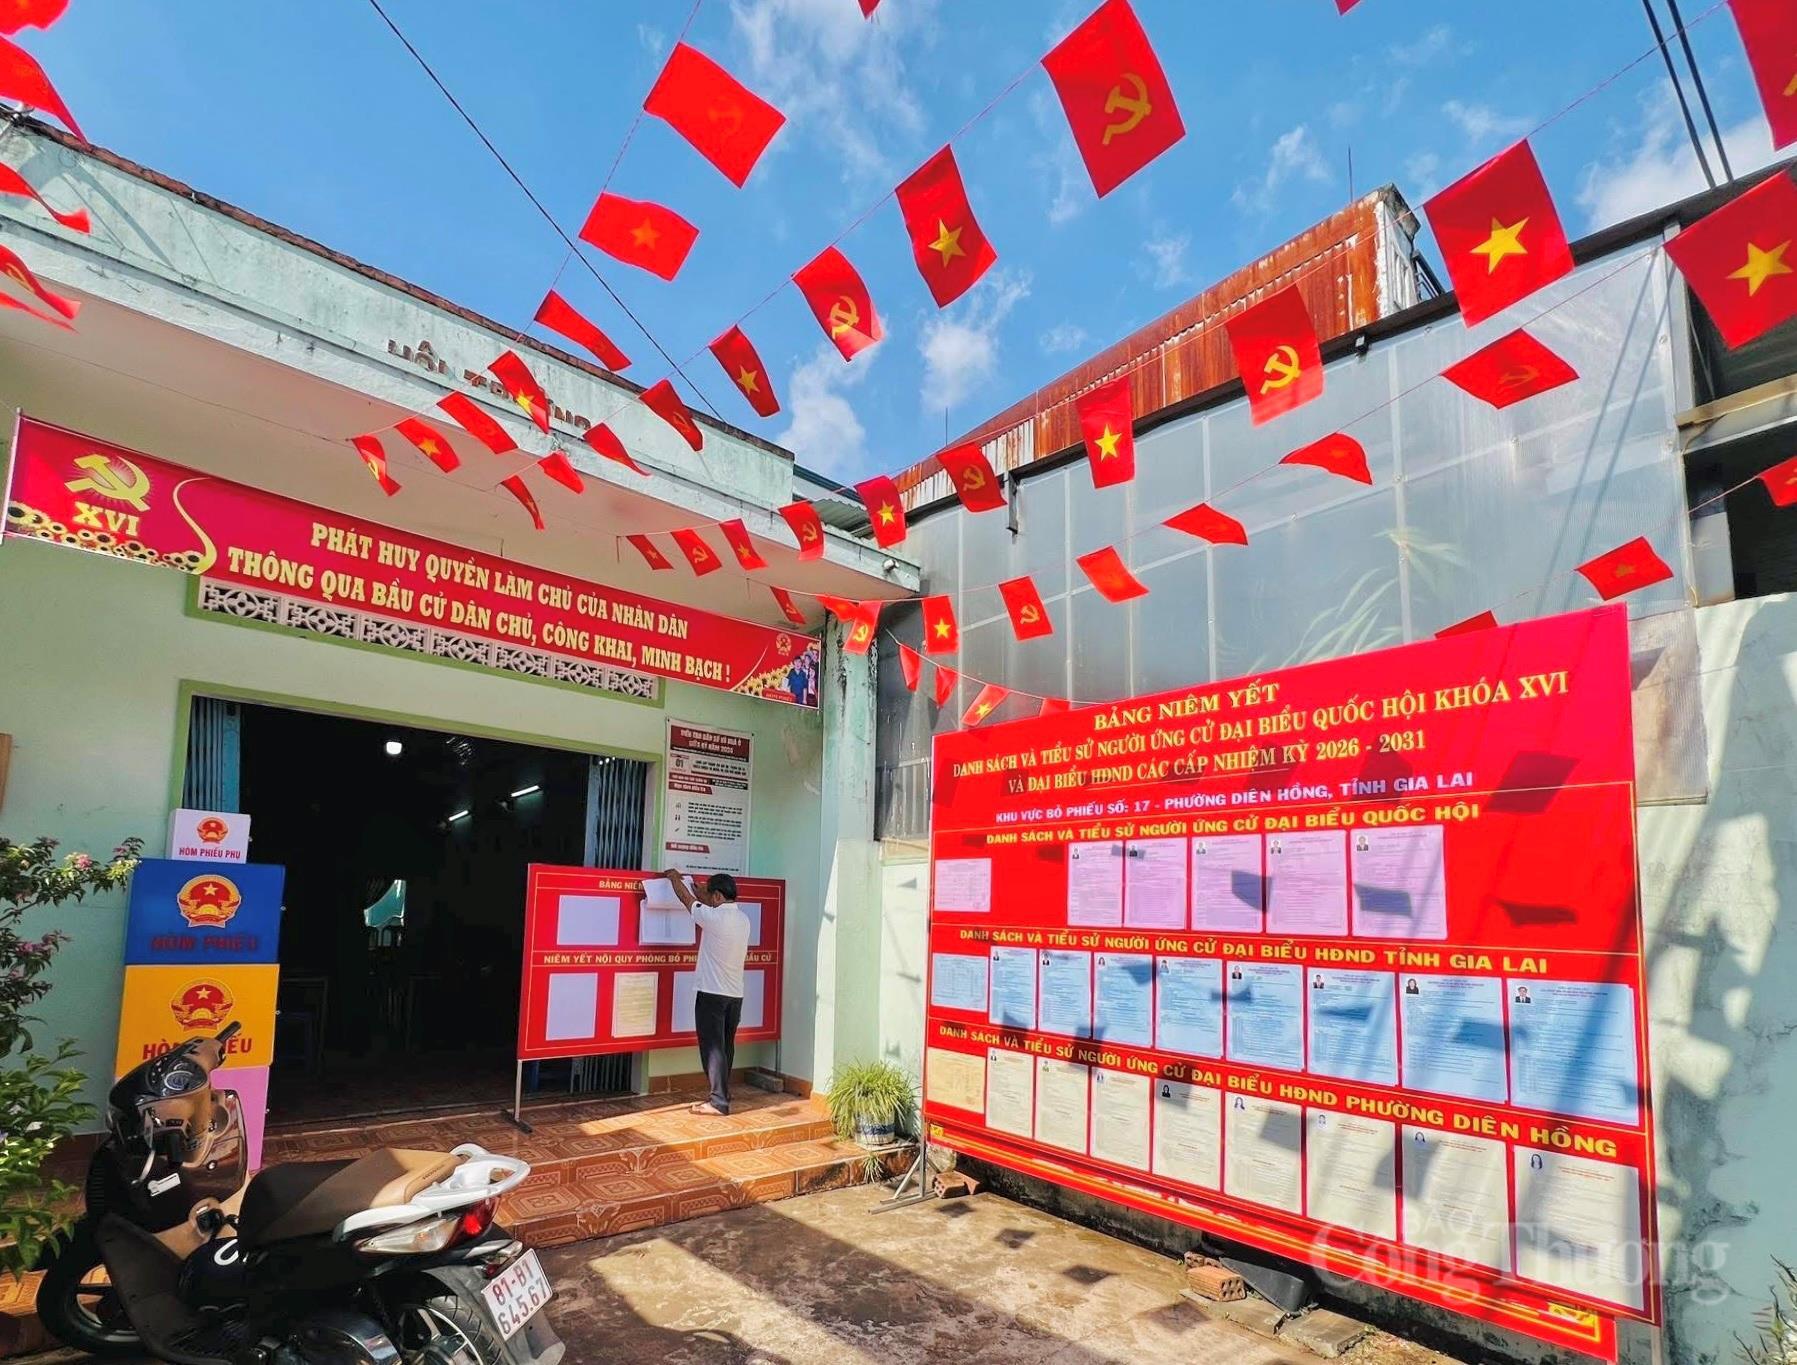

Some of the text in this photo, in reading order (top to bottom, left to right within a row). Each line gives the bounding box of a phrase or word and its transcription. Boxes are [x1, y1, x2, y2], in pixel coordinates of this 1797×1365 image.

[73, 503, 140, 536] XVI
[310, 522, 688, 640] PHÁT HUY QUYỀN LÀM CHỦ CỦA NHÂN DÂN
[228, 546, 315, 590] THÔNG
[320, 570, 365, 602] QUA
[370, 577, 414, 612] BẦU
[419, 592, 447, 620] CỬ
[451, 600, 491, 631] DÂN
[496, 613, 536, 646] CHỦ,
[542, 621, 589, 652] CÔNG
[594, 634, 636, 668] KHAI,
[641, 645, 681, 673] MINH
[685, 656, 723, 681] BẠCH
[953, 671, 1570, 777] DANH SÁCH VÀ TIỂU SỬ NGƯỜI ỨNG CỬ ĐẠI BIỂU QUỐC HỘI KHÓA XVI
[1094, 679, 1280, 730] BẢNG NIÊM YẾT
[1008, 775, 1025, 793] VÀ
[1028, 775, 1050, 793] ĐẠI
[1054, 765, 1087, 789] BIỂU
[1091, 766, 1133, 785] HĐND
[1136, 758, 1169, 779] CÁC
[1173, 749, 1208, 776] CẤP
[1213, 745, 1275, 772] NHIỆM
[1283, 738, 1309, 765] KỲ
[1315, 737, 1359, 760] 2026
[1379, 729, 1426, 753] 2031
[986, 801, 1479, 844] DANH SÁCH VÀ TIỂU SỬ NGƯỜI ỨNG CỬ ĐẠI BIỂU QUỐC HỘI
[996, 812, 1018, 823] KHU
[1021, 810, 1043, 822] VỰC
[1046, 804, 1063, 819] BỎ
[1066, 801, 1103, 817] PHIẾU
[1107, 797, 1129, 815] SỐ:
[1134, 799, 1150, 812] 17
[1165, 793, 1227, 810] PHƯỜNG
[1231, 789, 1271, 807] DIÊN
[1277, 782, 1333, 801] HỒNG,
[1340, 776, 1386, 795] TỈNH
[1393, 775, 1428, 792] GIA
[1436, 771, 1473, 789] LAI
[599, 879, 622, 889] BẢNG
[543, 953, 570, 964] NIÊM
[573, 952, 592, 964] YẾT
[595, 954, 612, 964] NỘI
[615, 955, 633, 964] QUY
[668, 952, 680, 963] BỎ
[960, 929, 1547, 974] DANH SÁCH VÀ TIỂU SỬ NGƯỜI ỨNG CỬ ĐẠI BIỂU HĐND TỈNH GIA LAI
[142, 1038, 181, 1060] HÒ
[939, 1026, 1617, 1159] DANH SÁCH VÀ TIỂU SỬ NGƯỜI ỨNG CỬ ĐẠI BIỂU HĐND PHƯỜNG DIÊN HỒNG
[492, 1259, 533, 1306] 81-B1
[498, 1276, 547, 1334] 645.67
